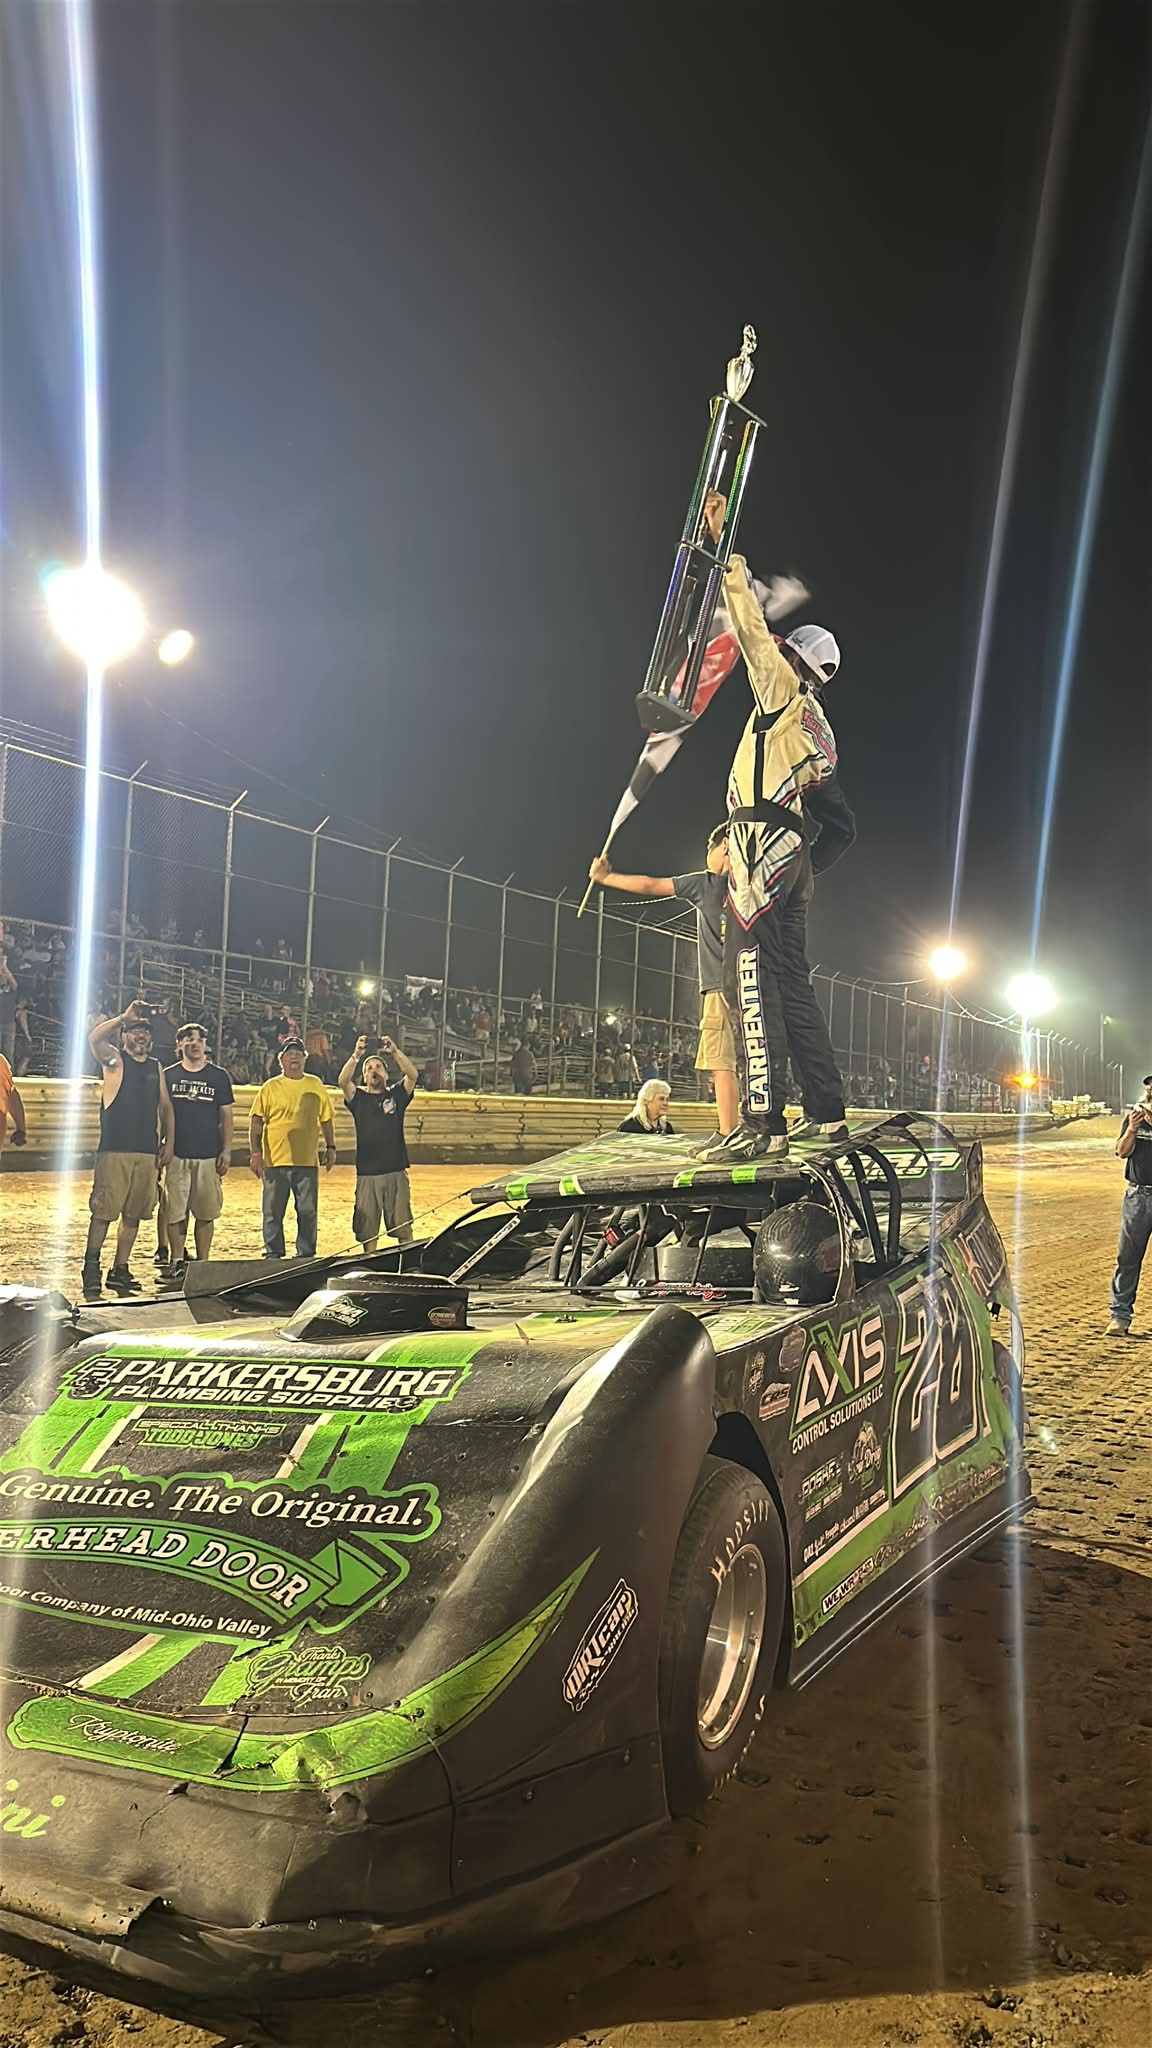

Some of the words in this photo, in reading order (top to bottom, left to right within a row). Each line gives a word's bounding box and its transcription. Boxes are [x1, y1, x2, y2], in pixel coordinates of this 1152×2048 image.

[738, 949, 771, 1112] CARPENTER
[111, 1360, 456, 1396] PARKERSBURG
[796, 1316, 884, 1424] AXIS
[113, 1385, 268, 1402] PLUMBING
[139, 1420, 208, 1430] SPECIAL
[216, 1423, 281, 1434] THANKS
[148, 1428, 193, 1444] TODD
[195, 1431, 258, 1447] JONES
[792, 1419, 829, 1454] CONTROL
[830, 1394, 871, 1429] SOLUTIONS
[872, 1384, 884, 1405] LLC
[0, 1475, 154, 1509] Genuine.
[169, 1485, 242, 1514] The
[251, 1491, 422, 1528] Original.
[190, 1541, 308, 1608] DOOR
[0, 1582, 30, 1598] oor
[31, 1591, 110, 1617] Company
[111, 1606, 134, 1618] of
[131, 1607, 213, 1629] Mid-Ohio
[216, 1616, 272, 1638] Valley
[250, 1652, 365, 1690] Gramps
[301, 1648, 341, 1662] Thanks
[294, 1682, 342, 1702] Fran
